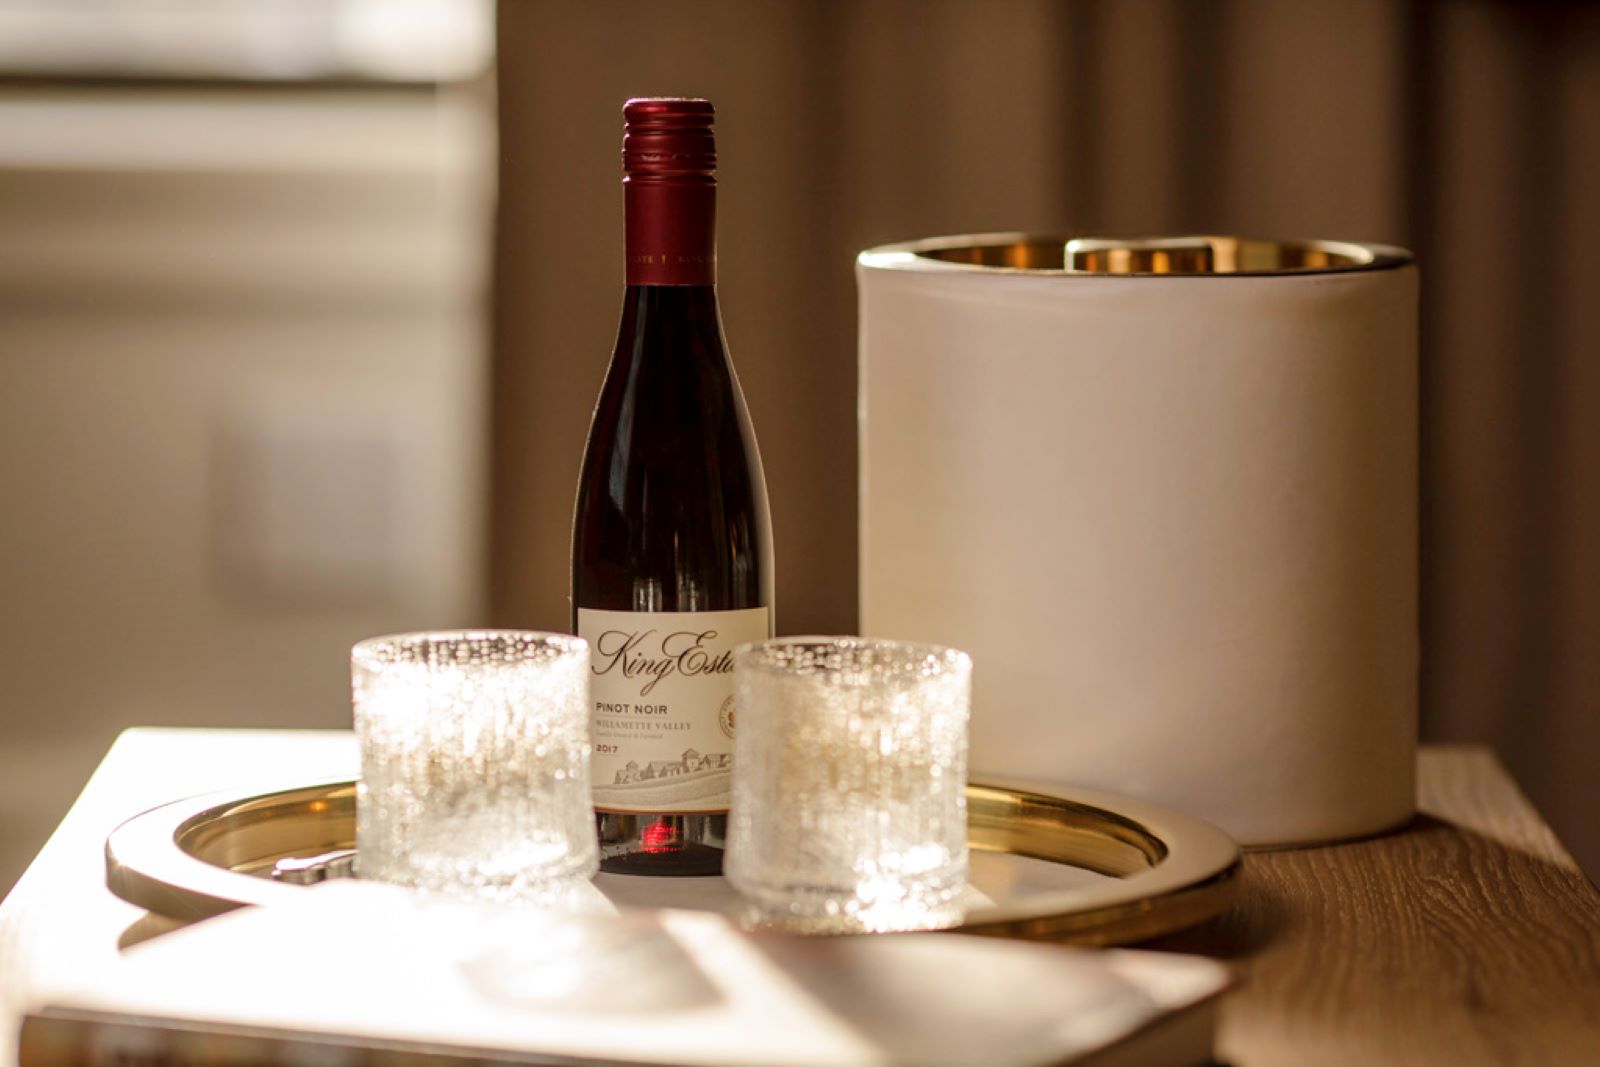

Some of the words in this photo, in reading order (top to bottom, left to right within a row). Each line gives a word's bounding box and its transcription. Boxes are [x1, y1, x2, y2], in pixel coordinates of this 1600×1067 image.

[591, 629, 675, 697] King
[661, 629, 736, 676] Esta
[595, 702, 630, 714] PINOT
[634, 704, 668, 715] NOIR
[655, 721, 692, 731] VALLEY
[595, 744, 618, 754] 2017
